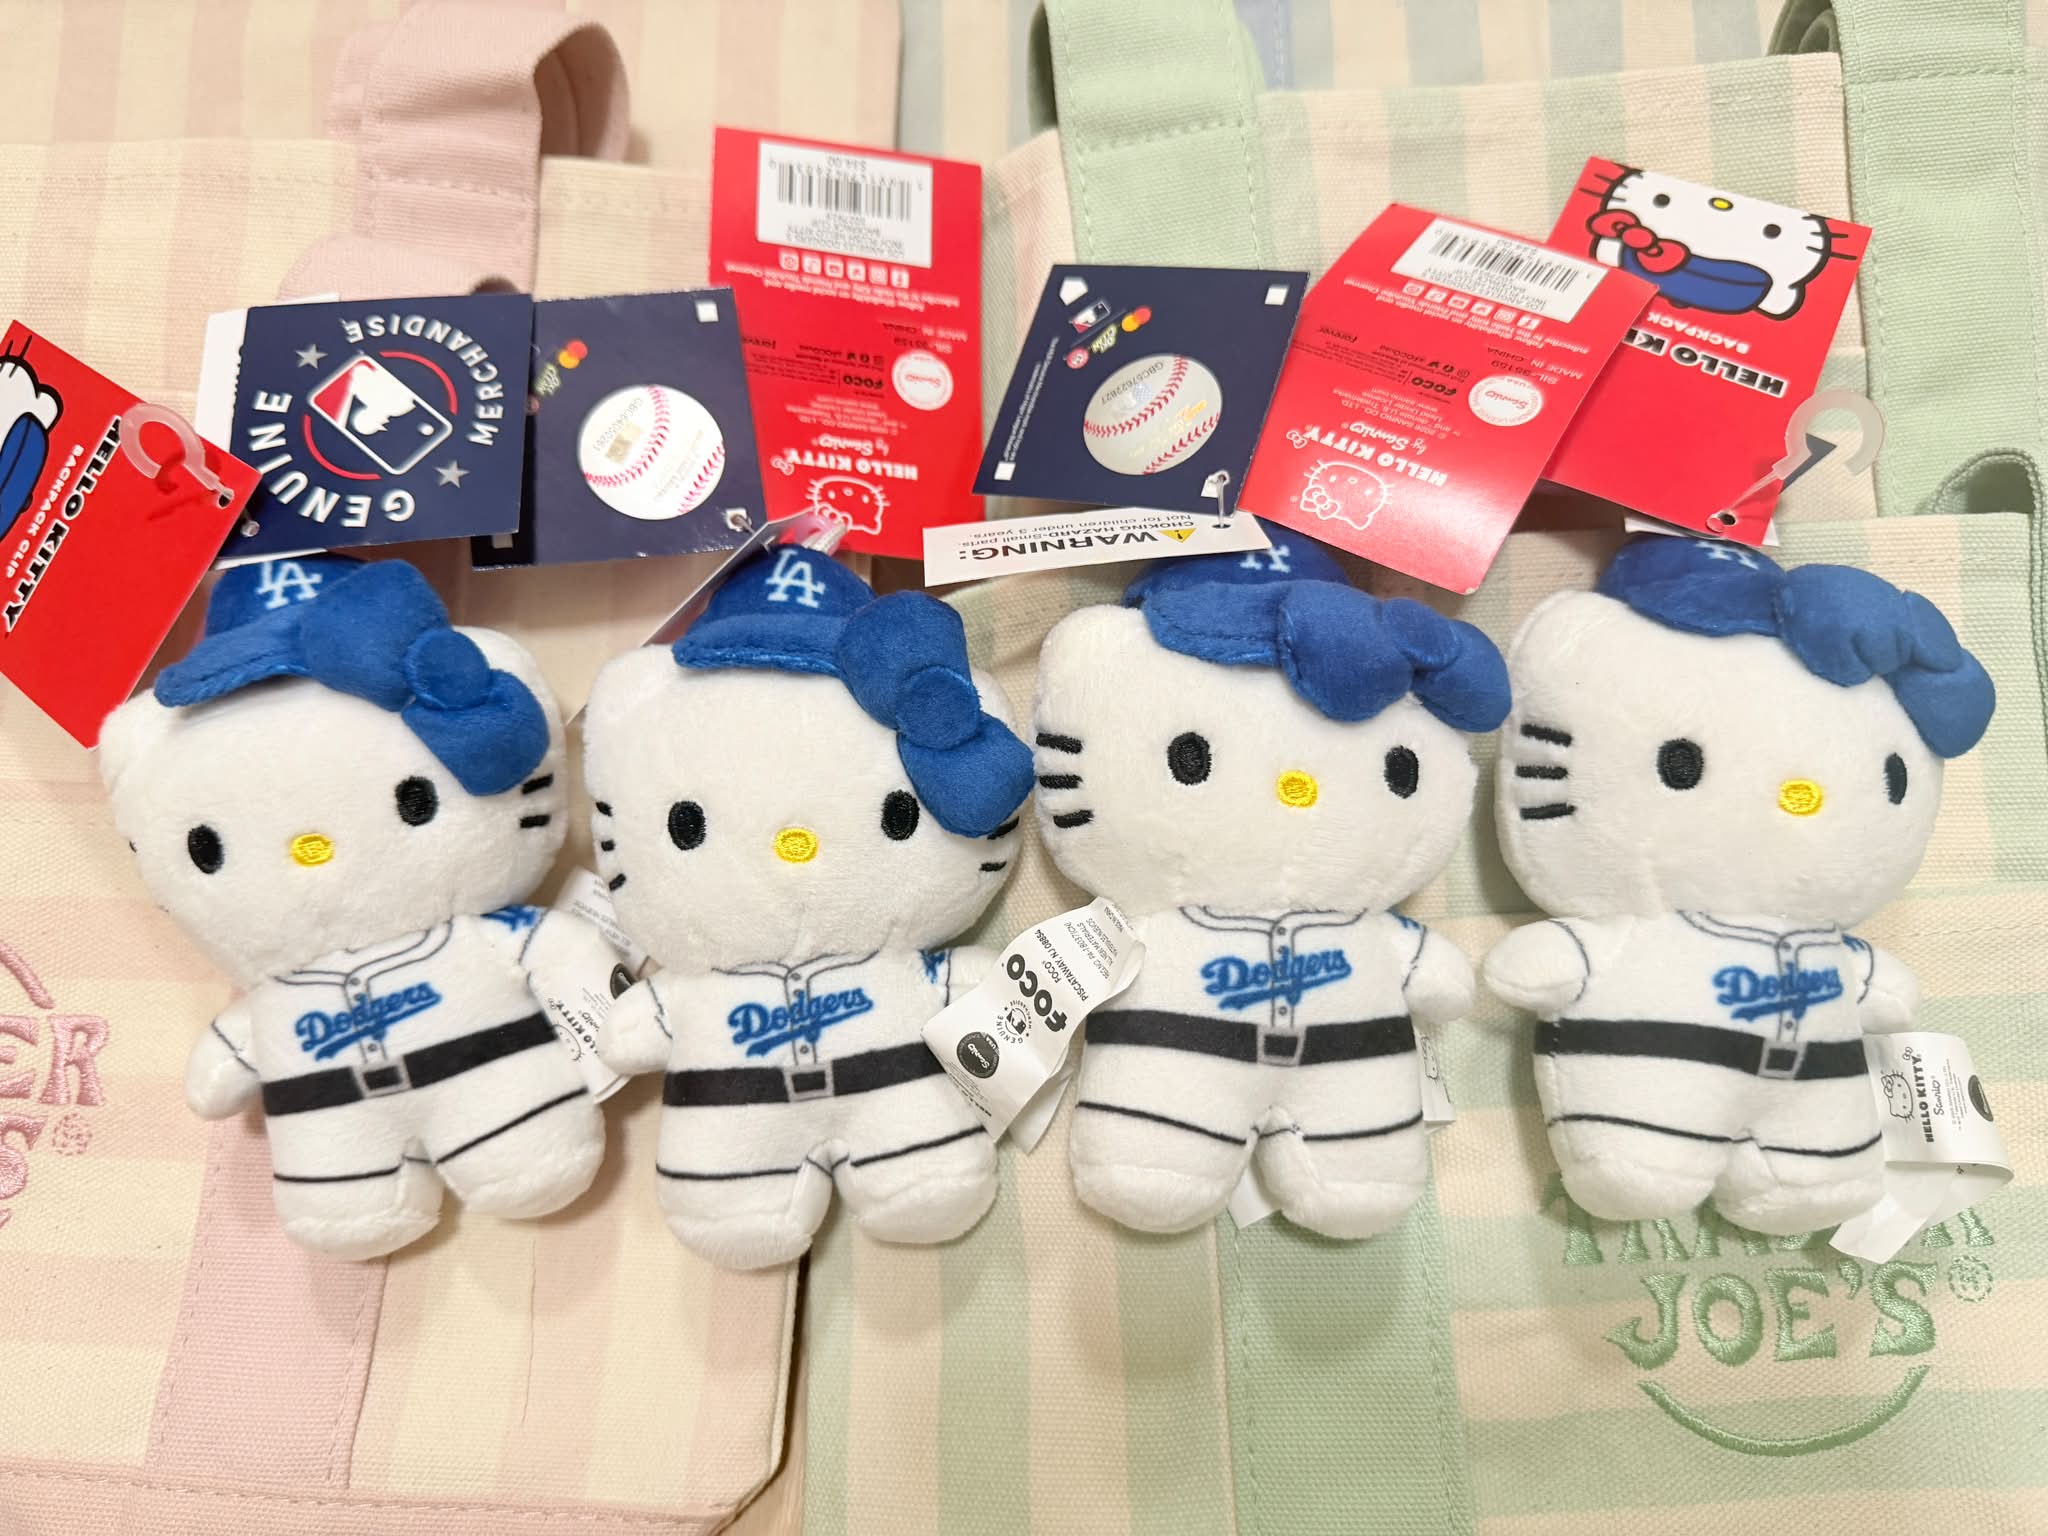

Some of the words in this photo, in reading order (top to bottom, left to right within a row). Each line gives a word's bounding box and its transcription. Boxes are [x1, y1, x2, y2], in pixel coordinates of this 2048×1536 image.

[1646, 309, 1749, 354] BACKPACK
[1486, 346, 1524, 362] CHINA
[1530, 358, 1543, 368] IN
[1545, 362, 1583, 381] MADE
[1668, 343, 1786, 397] HELLO
[340, 314, 504, 446] MERCHANDISE
[249, 390, 416, 527] GENUINE
[785, 448, 853, 471] KITTY
[1302, 423, 1375, 461] KITTY
[1409, 436, 1427, 455] by
[854, 457, 918, 480] HELLO
[1376, 450, 1448, 485] HELLO
[27, 442, 85, 536] BACKPACK
[1030, 523, 1075, 533] under
[1083, 518, 1137, 527] children
[1118, 519, 1194, 531] CHOKING
[3, 536, 33, 578] CLIP
[958, 529, 1158, 561] WARNING:
[0, 519, 70, 629] KITTY
[257, 562, 322, 610] LA
[766, 549, 825, 608] LA
[1034, 927, 1052, 949] 08854
[1047, 946, 1059, 958] NJ
[1076, 920, 1102, 950] MATERIALS
[1042, 960, 1062, 983] FOCO
[1054, 955, 1090, 1001] PISCATAWAY,
[1201, 947, 1352, 1009] Dodgers
[1712, 962, 1844, 1021] Dodgers
[295, 982, 442, 1061] Dodgers
[555, 1001, 585, 1034] KITTY
[727, 987, 874, 1057] Dodgers
[997, 1014, 1024, 1045] GENUINE
[984, 1035, 997, 1050] USA
[1911, 1054, 1926, 1098] KITTY
[1918, 1100, 1934, 1142] HELLO
[1602, 1260, 1938, 1370] JOE'S
